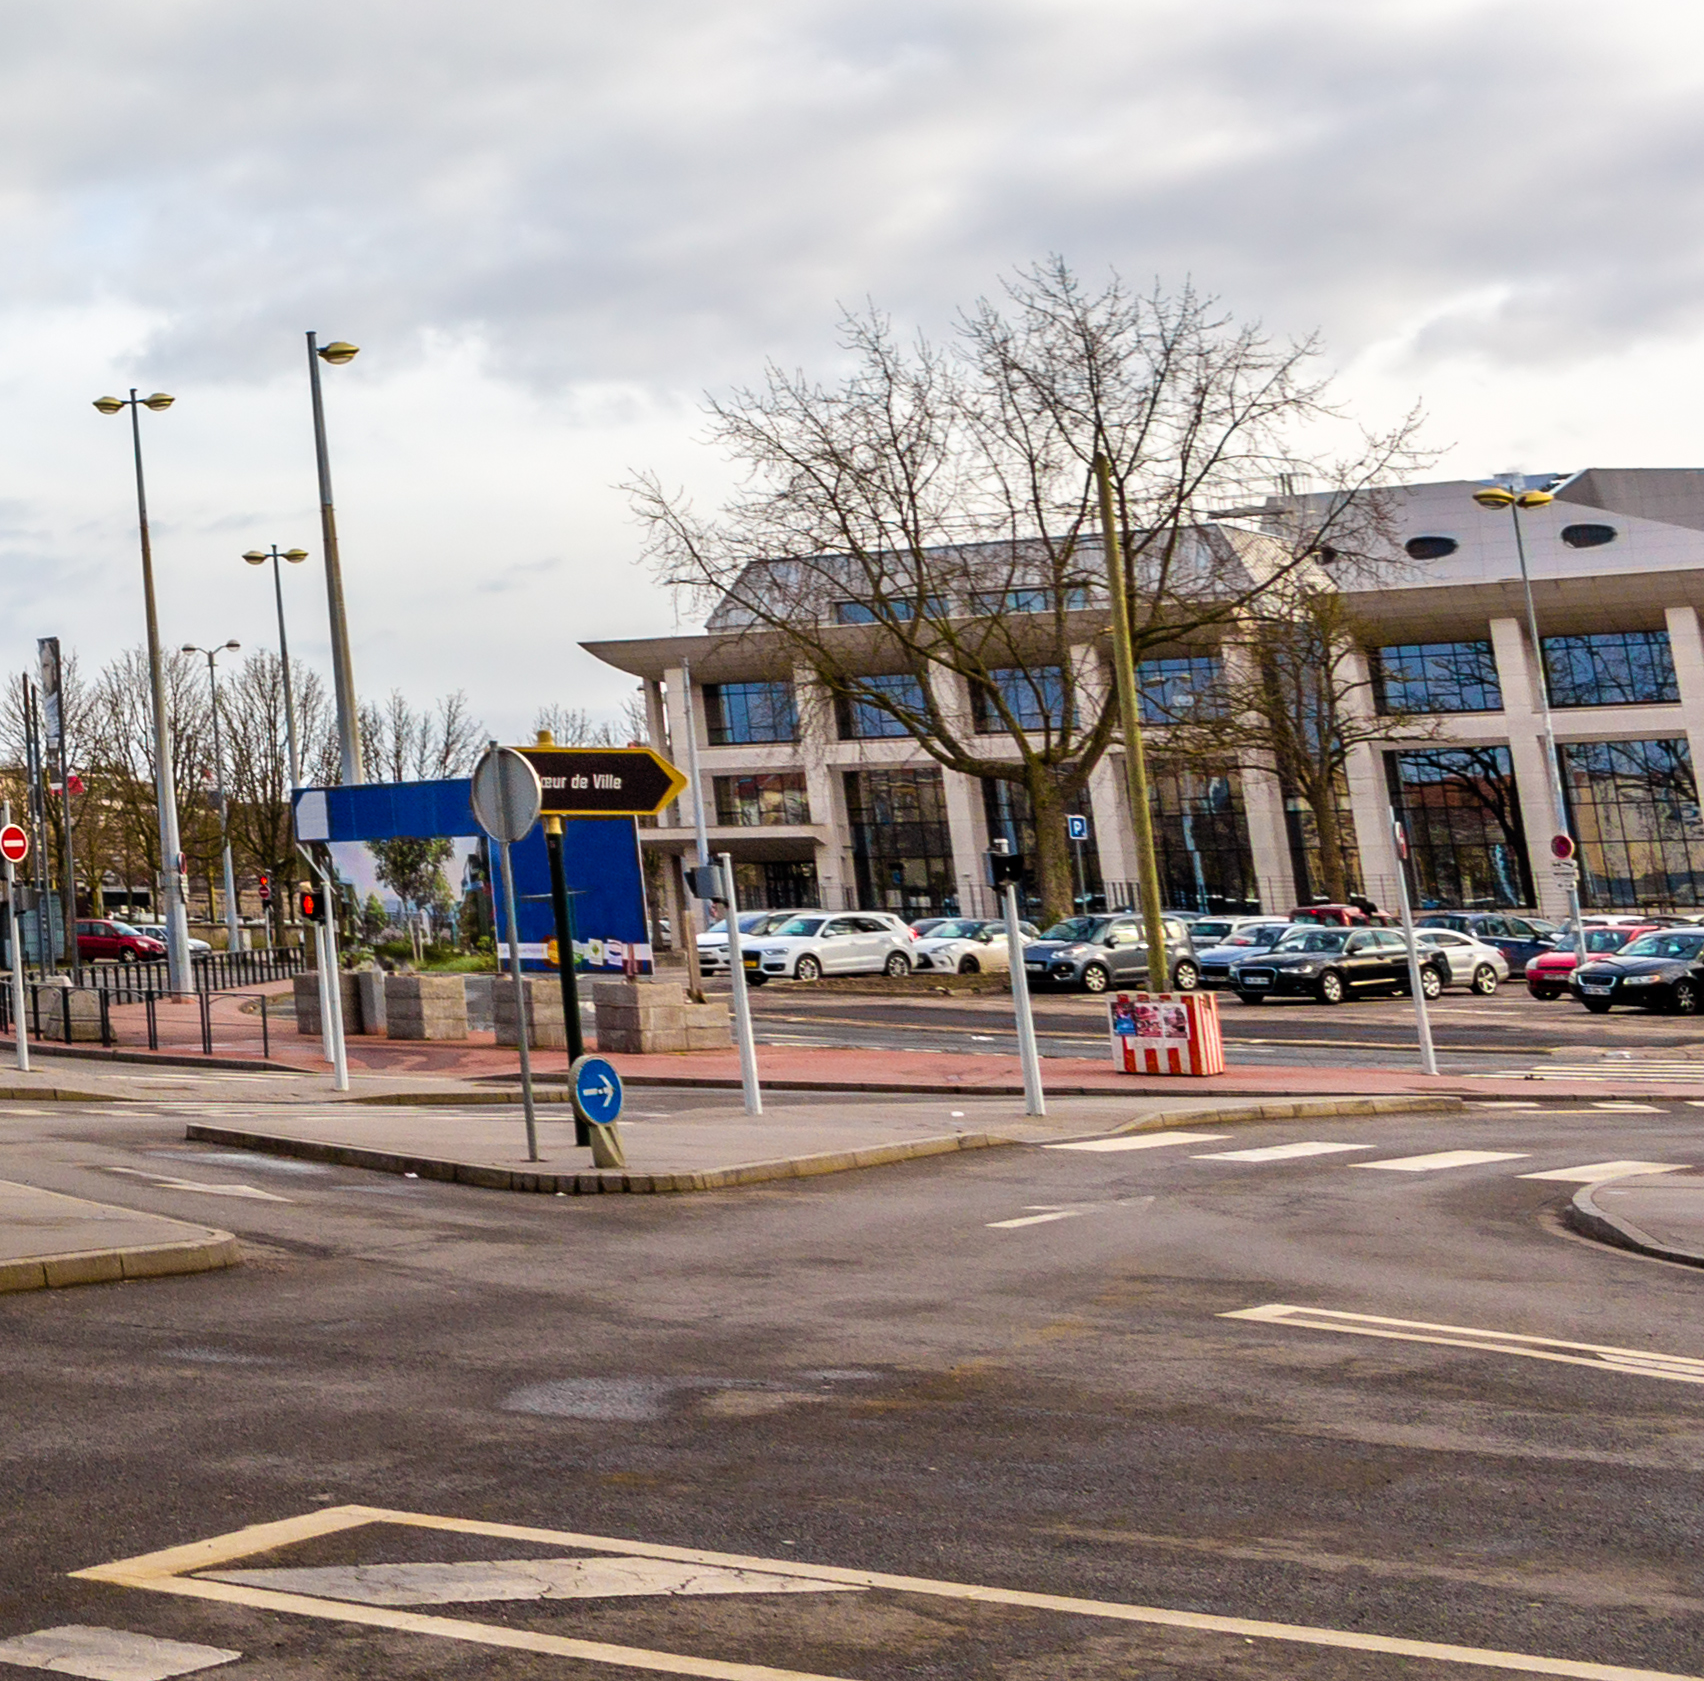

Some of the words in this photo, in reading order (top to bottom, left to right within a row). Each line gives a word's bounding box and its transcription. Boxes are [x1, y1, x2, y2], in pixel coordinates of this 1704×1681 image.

[541, 776, 567, 789] œur
[571, 773, 589, 789] de
[592, 773, 622, 790] Ville
